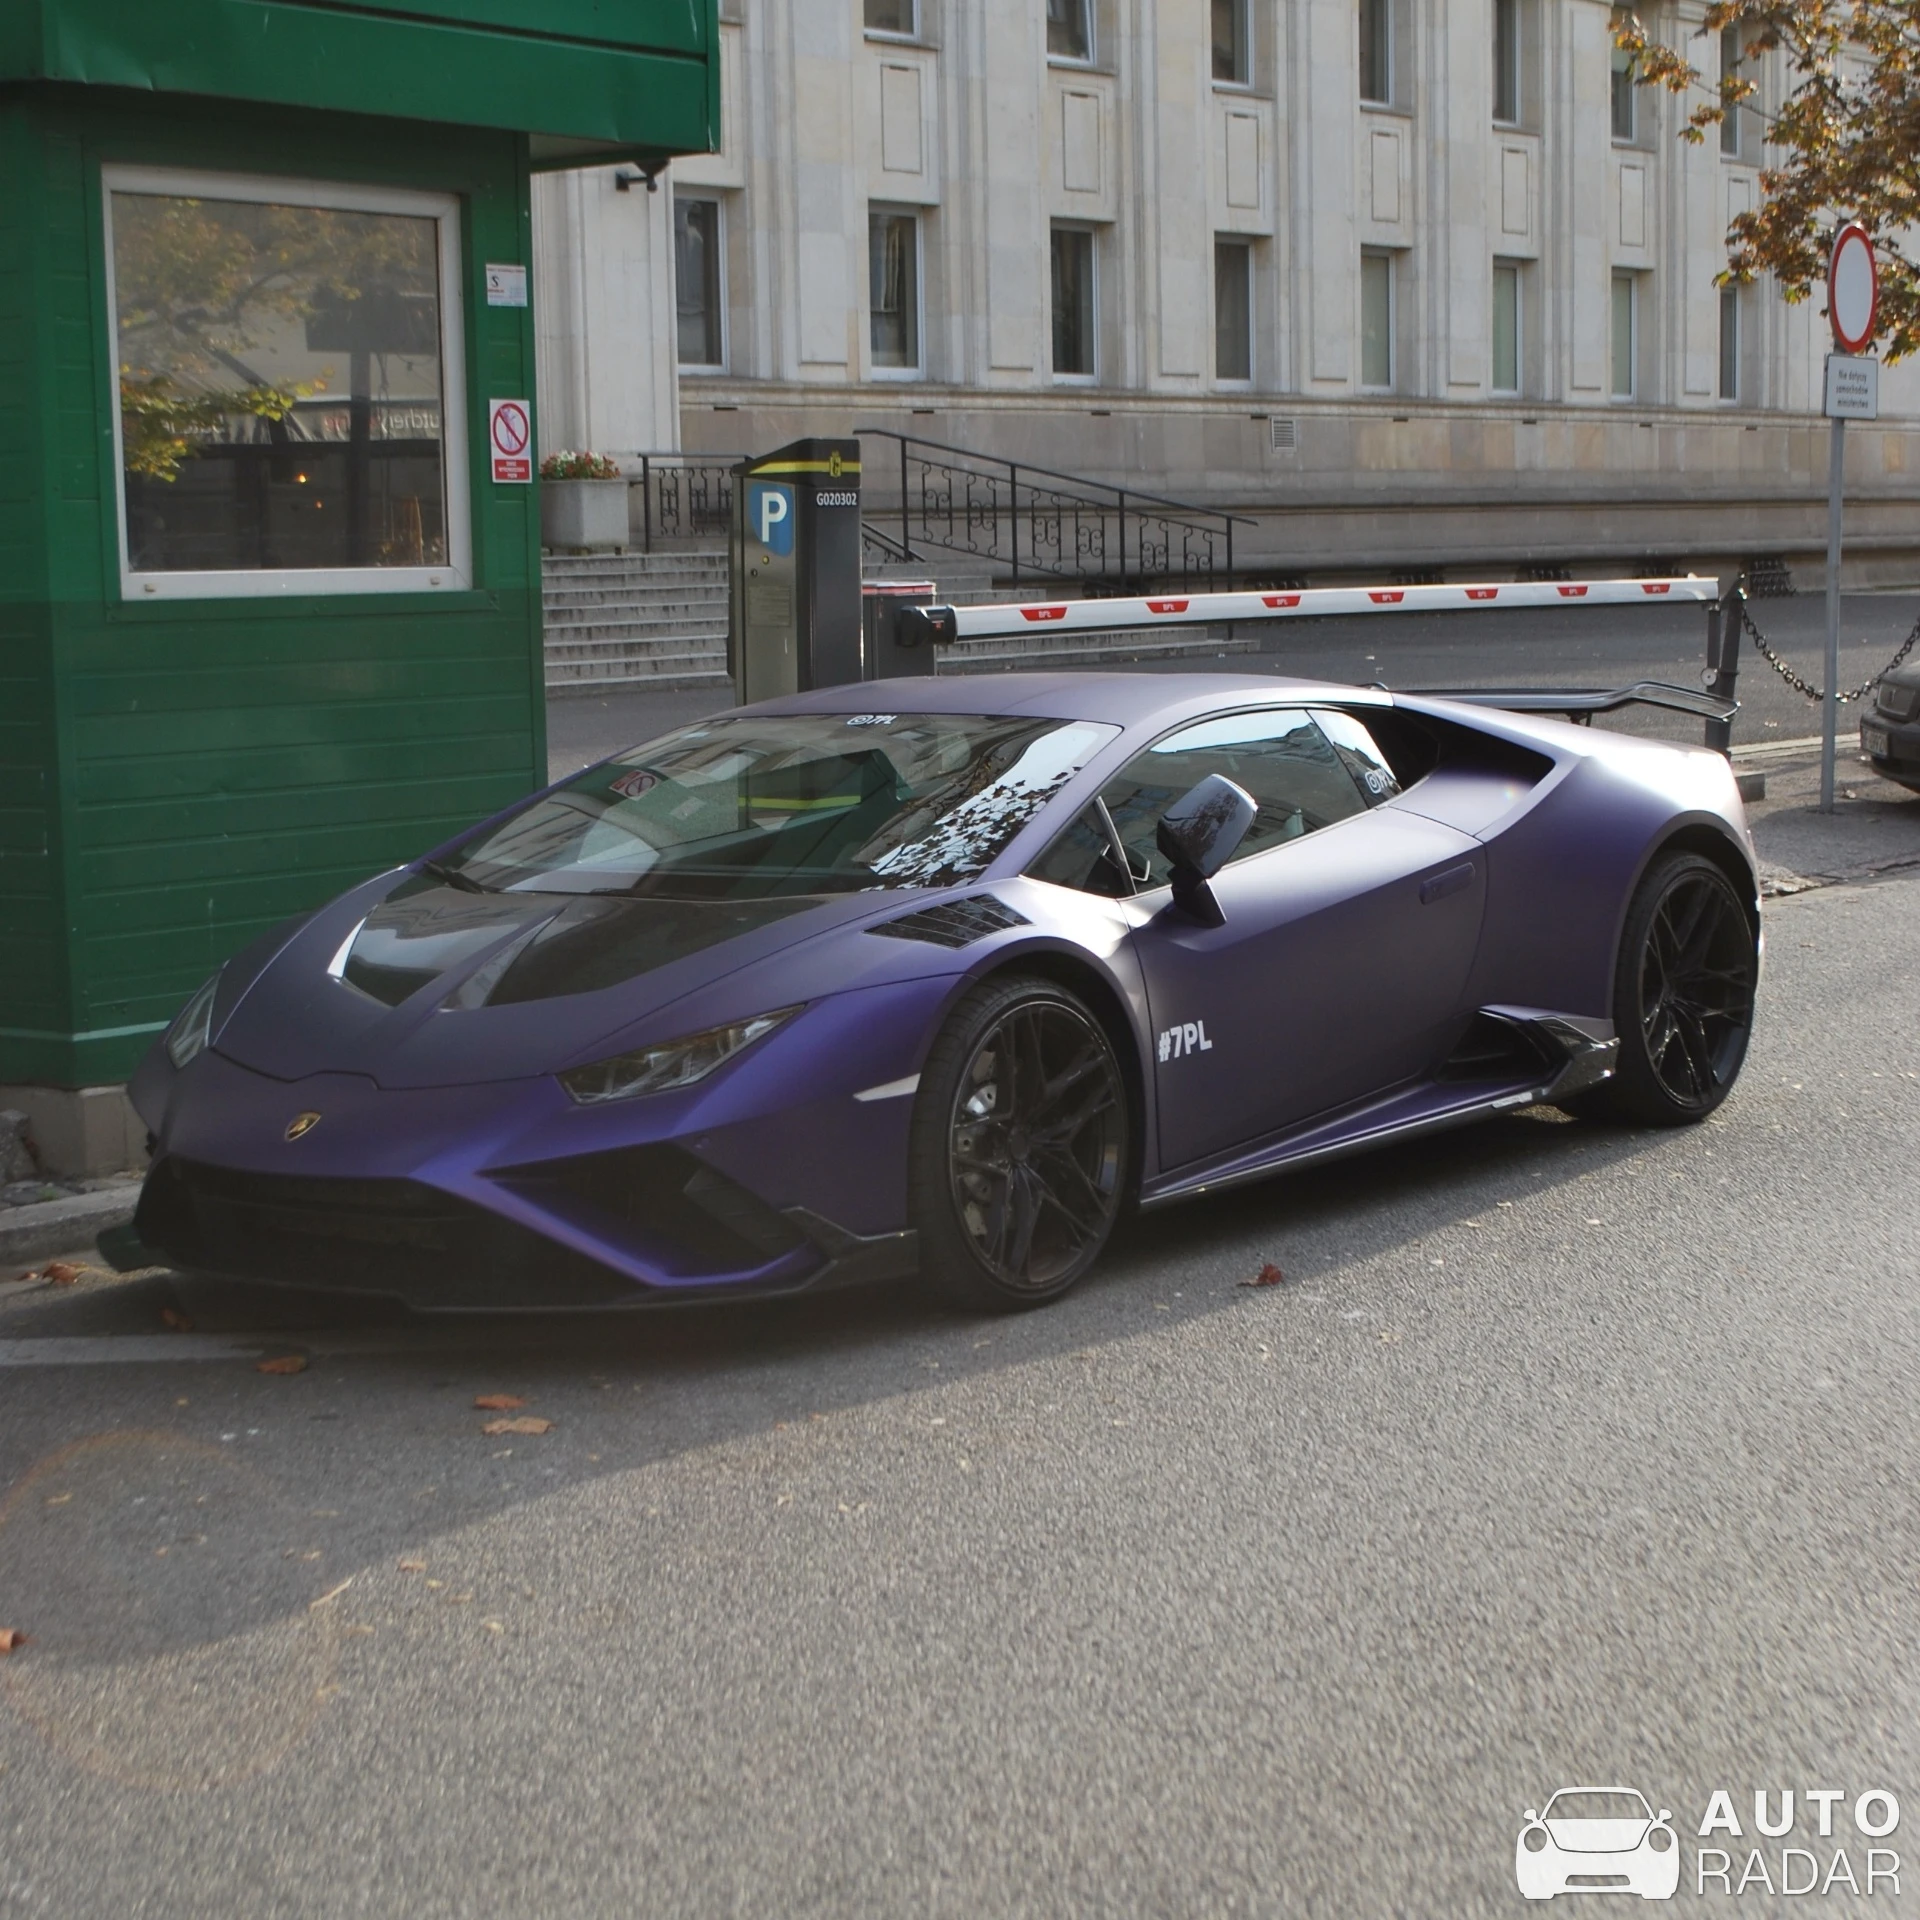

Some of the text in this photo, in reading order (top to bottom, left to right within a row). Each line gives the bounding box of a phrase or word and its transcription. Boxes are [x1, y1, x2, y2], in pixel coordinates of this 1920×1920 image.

[762, 492, 787, 542] P
[816, 492, 857, 506] G020302
[1159, 1020, 1212, 1062] #7PL
